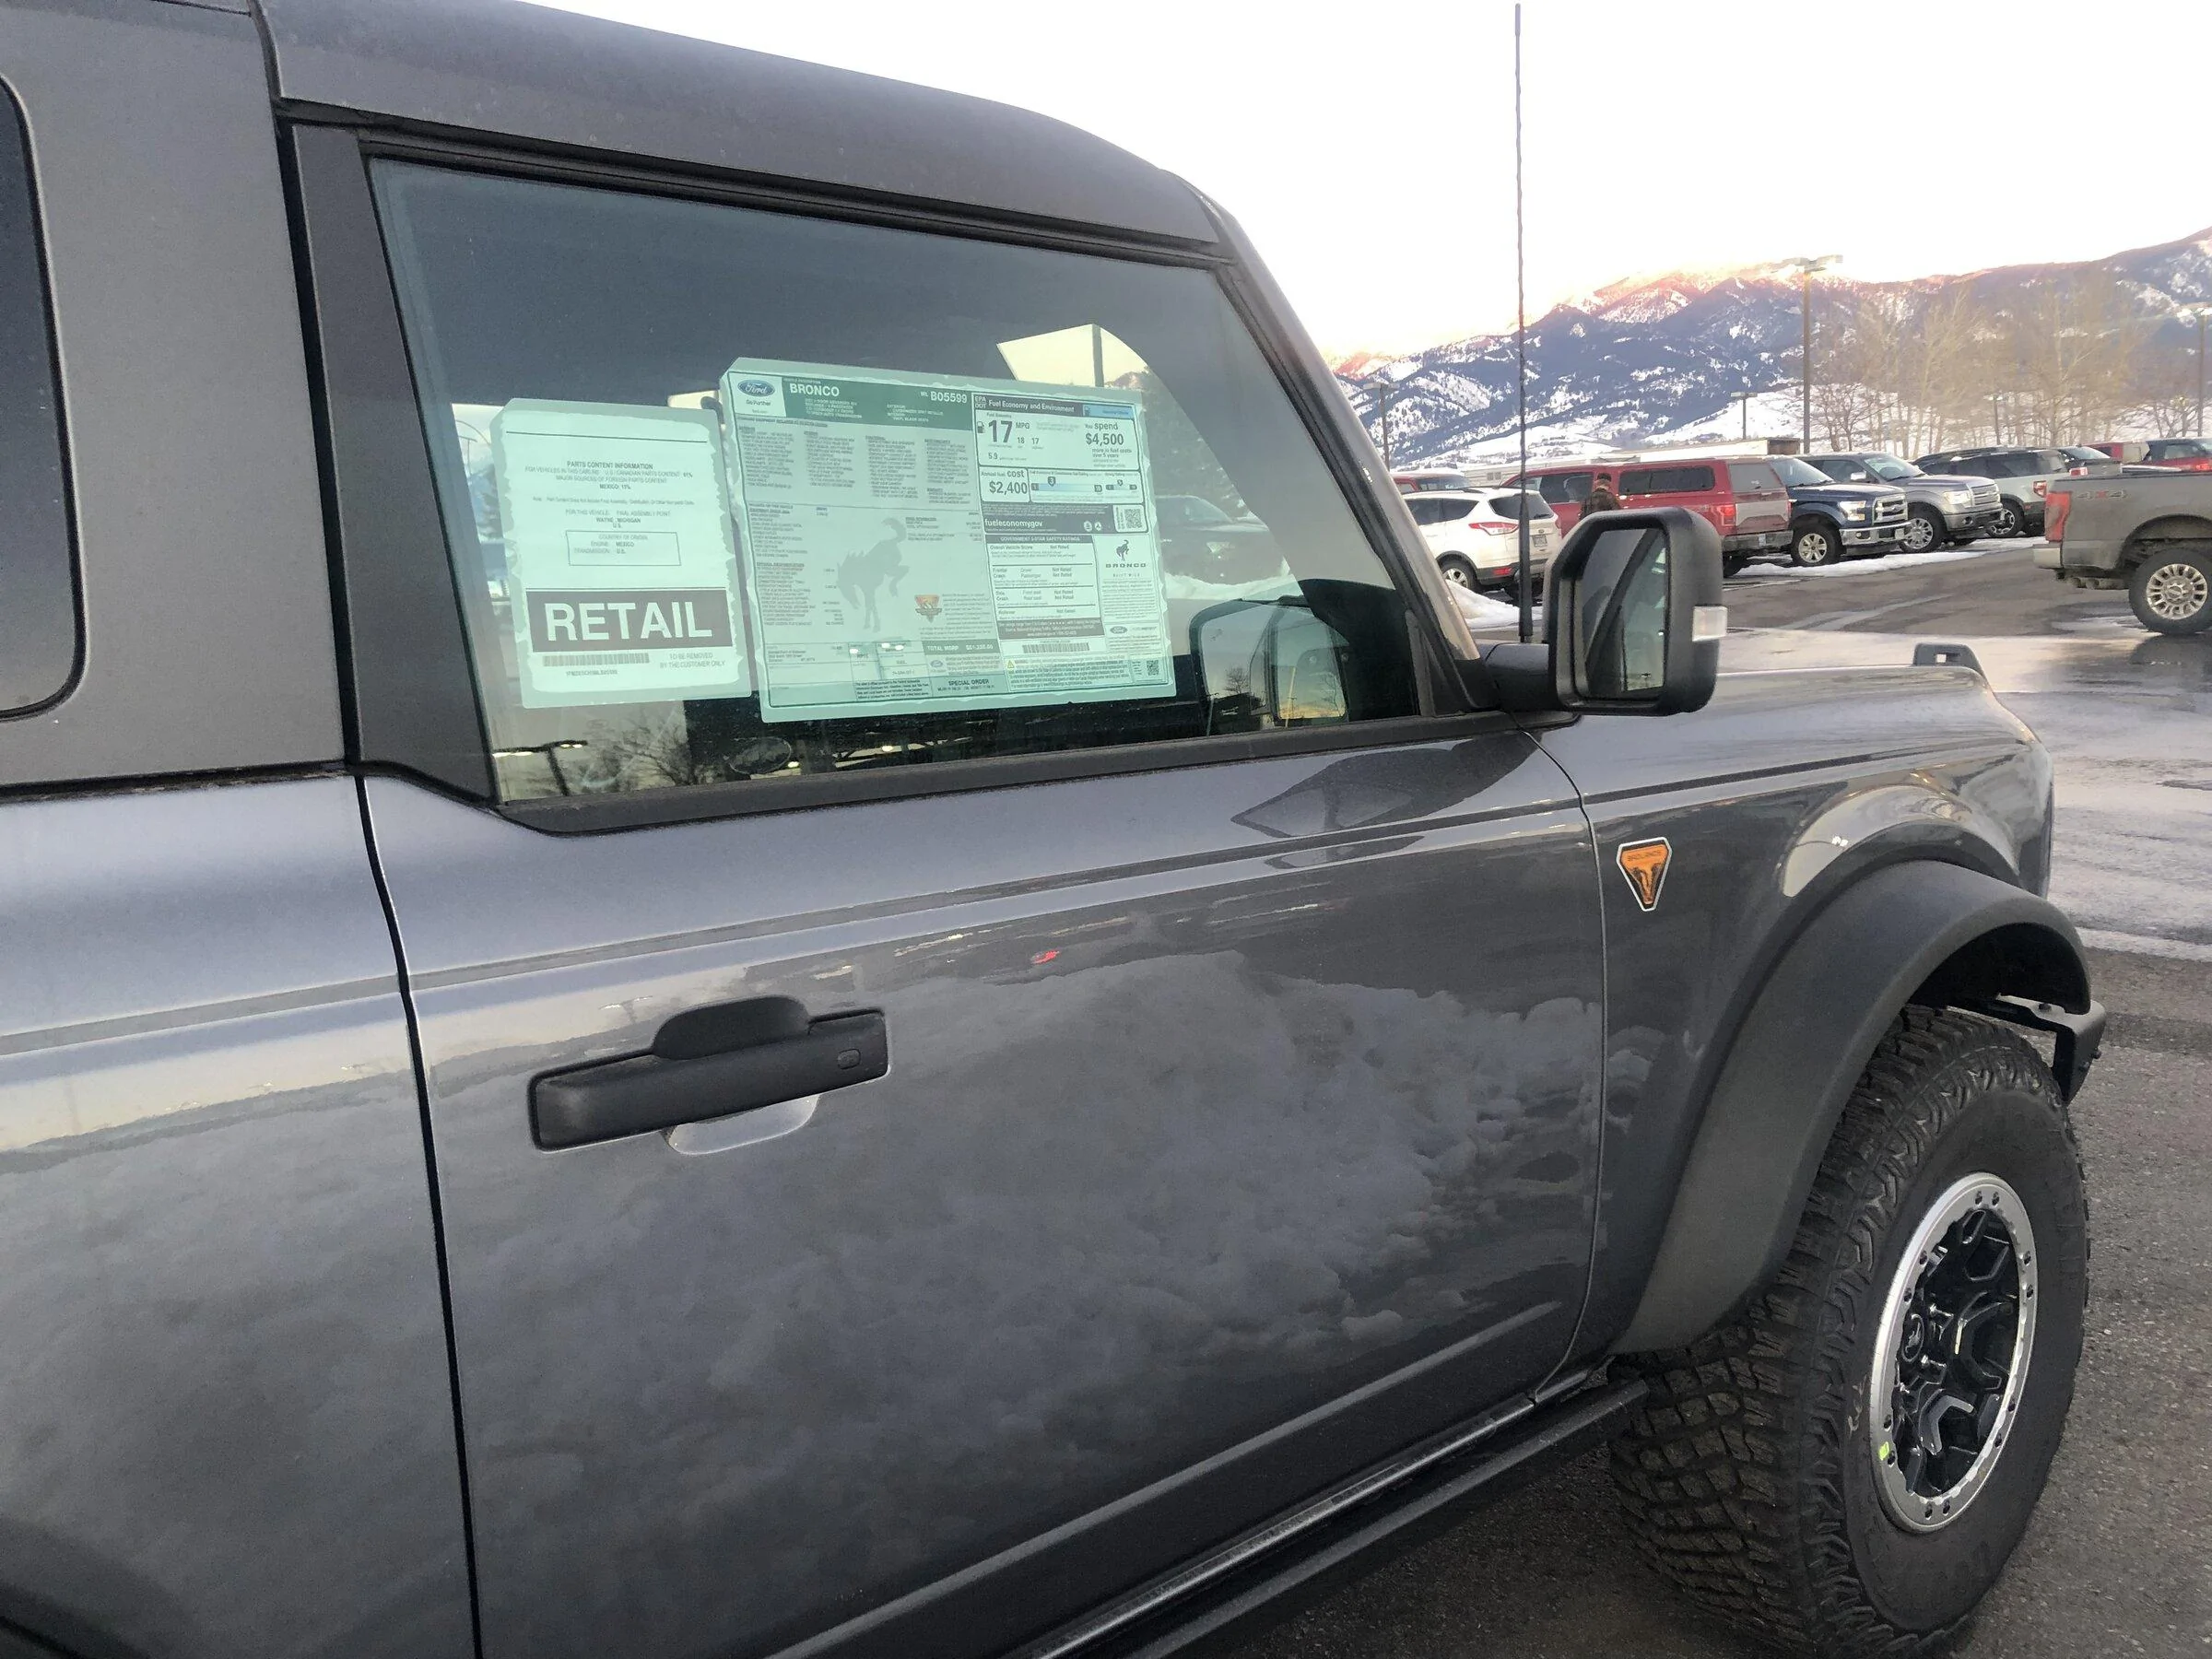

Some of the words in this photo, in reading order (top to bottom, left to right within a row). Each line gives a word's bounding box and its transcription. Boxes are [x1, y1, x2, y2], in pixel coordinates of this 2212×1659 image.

[790, 382, 840, 396] BRONCO
[930, 391, 968, 404] B05599
[988, 398, 1002, 407] Fuel
[1002, 400, 1029, 410] Economy
[1030, 402, 1041, 410] and
[1041, 403, 1075, 413] Environment
[988, 419, 1013, 443] 17
[1094, 422, 1119, 431] spend
[1085, 432, 1124, 447] $4,500
[988, 452, 998, 460] 5.9
[587, 461, 614, 469] CONTENT
[615, 462, 653, 470] INFORMATION
[1006, 469, 1025, 478] cost
[989, 480, 1028, 496] $2,400
[544, 601, 713, 641] RETAIL
